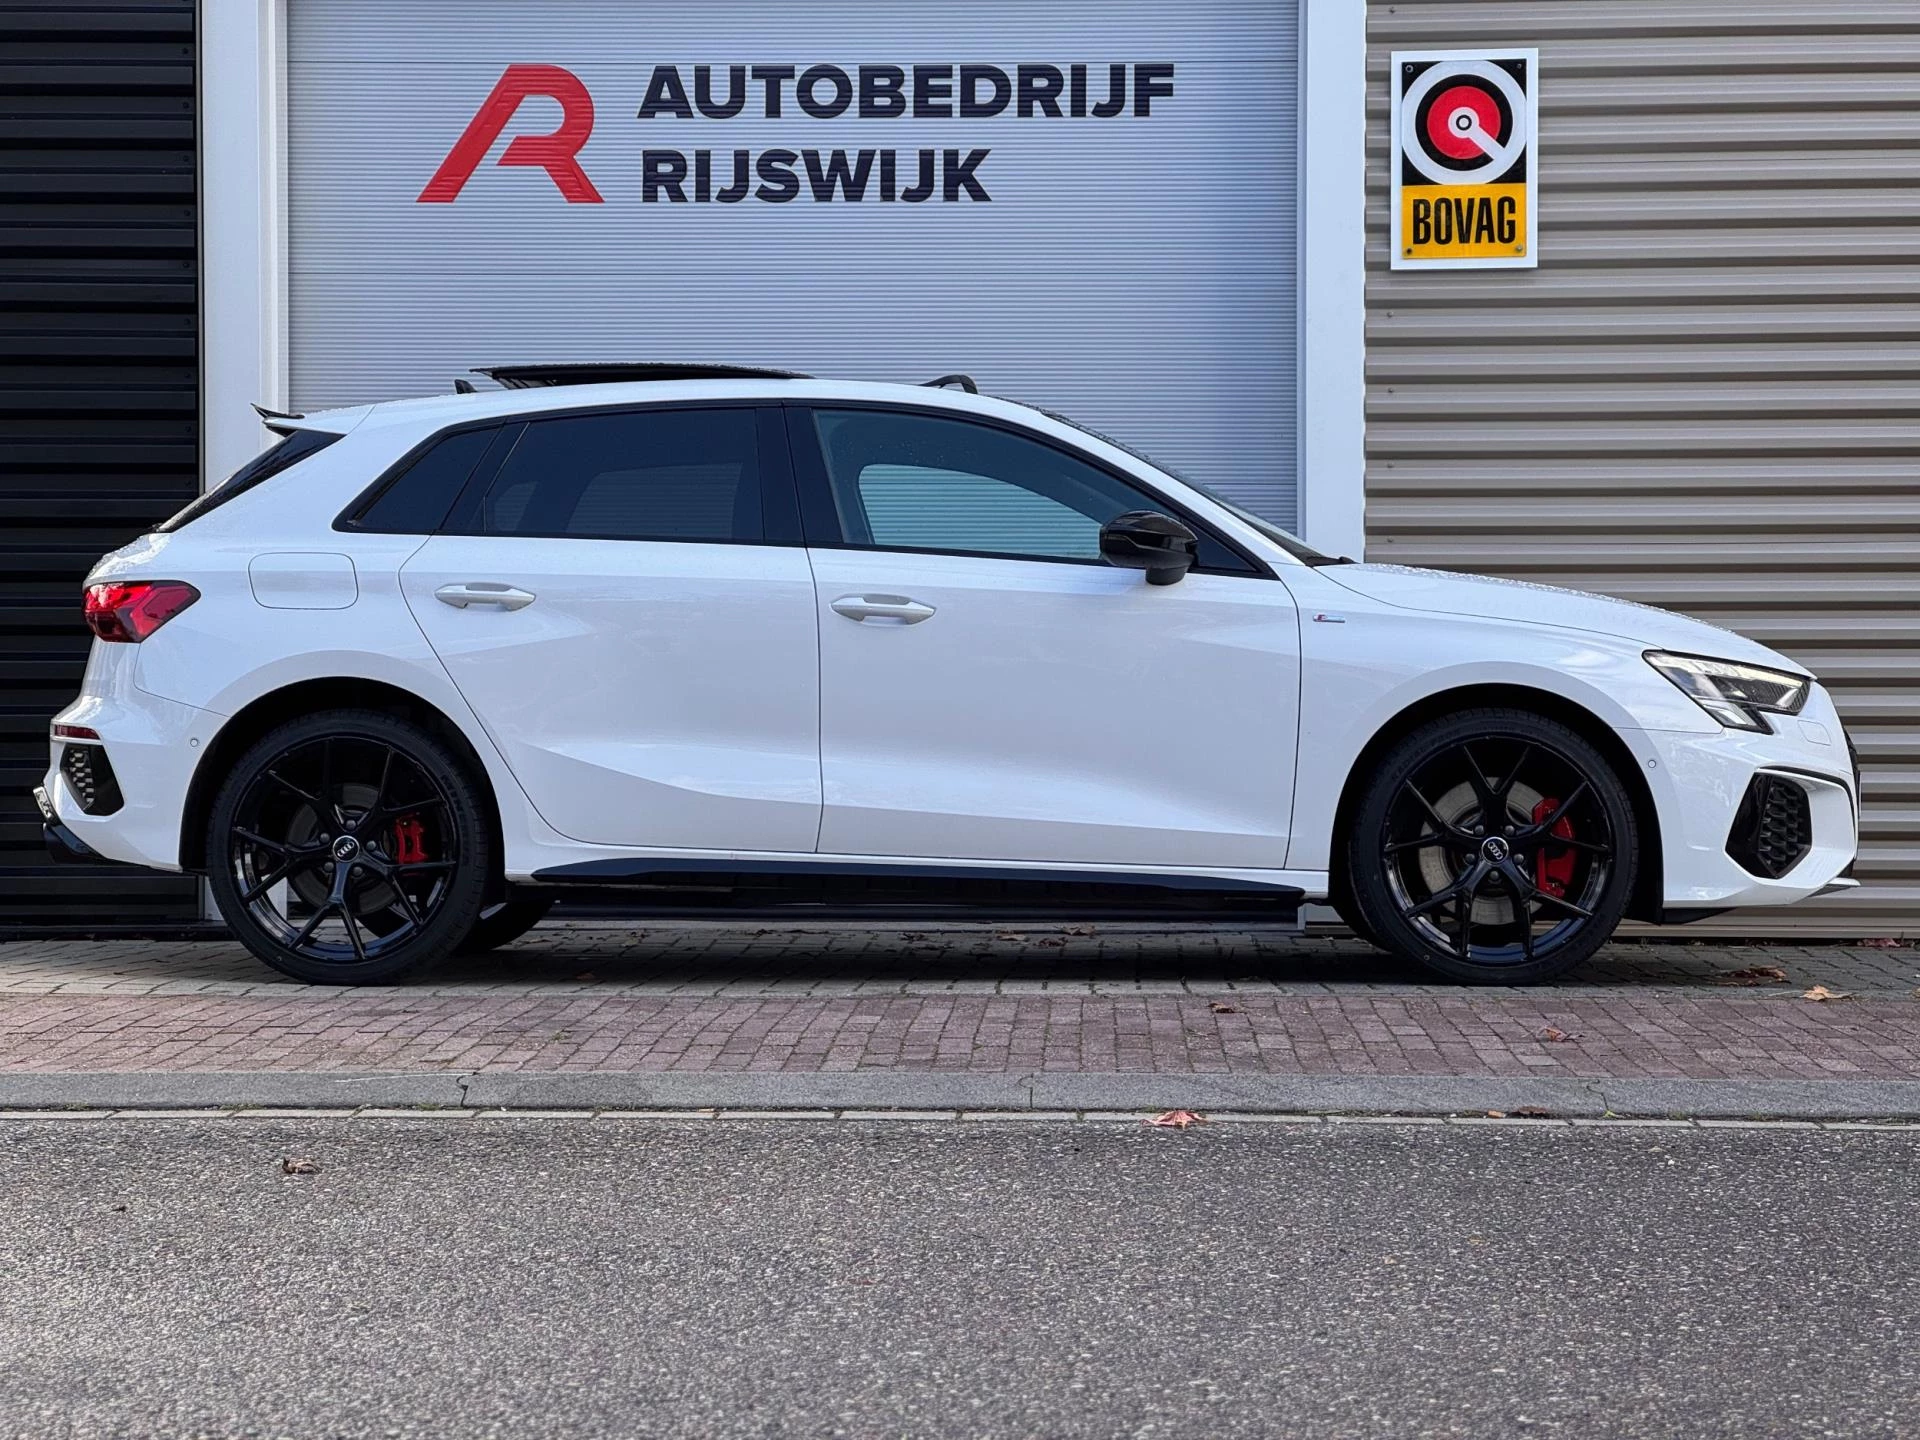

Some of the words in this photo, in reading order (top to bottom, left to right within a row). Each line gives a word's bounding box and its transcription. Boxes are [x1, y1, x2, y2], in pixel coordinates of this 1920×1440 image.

[637, 64, 1175, 119] AUTOBEDRIJF
[642, 149, 992, 203] RIJSWIJK
[1412, 196, 1516, 245] BOVAG
